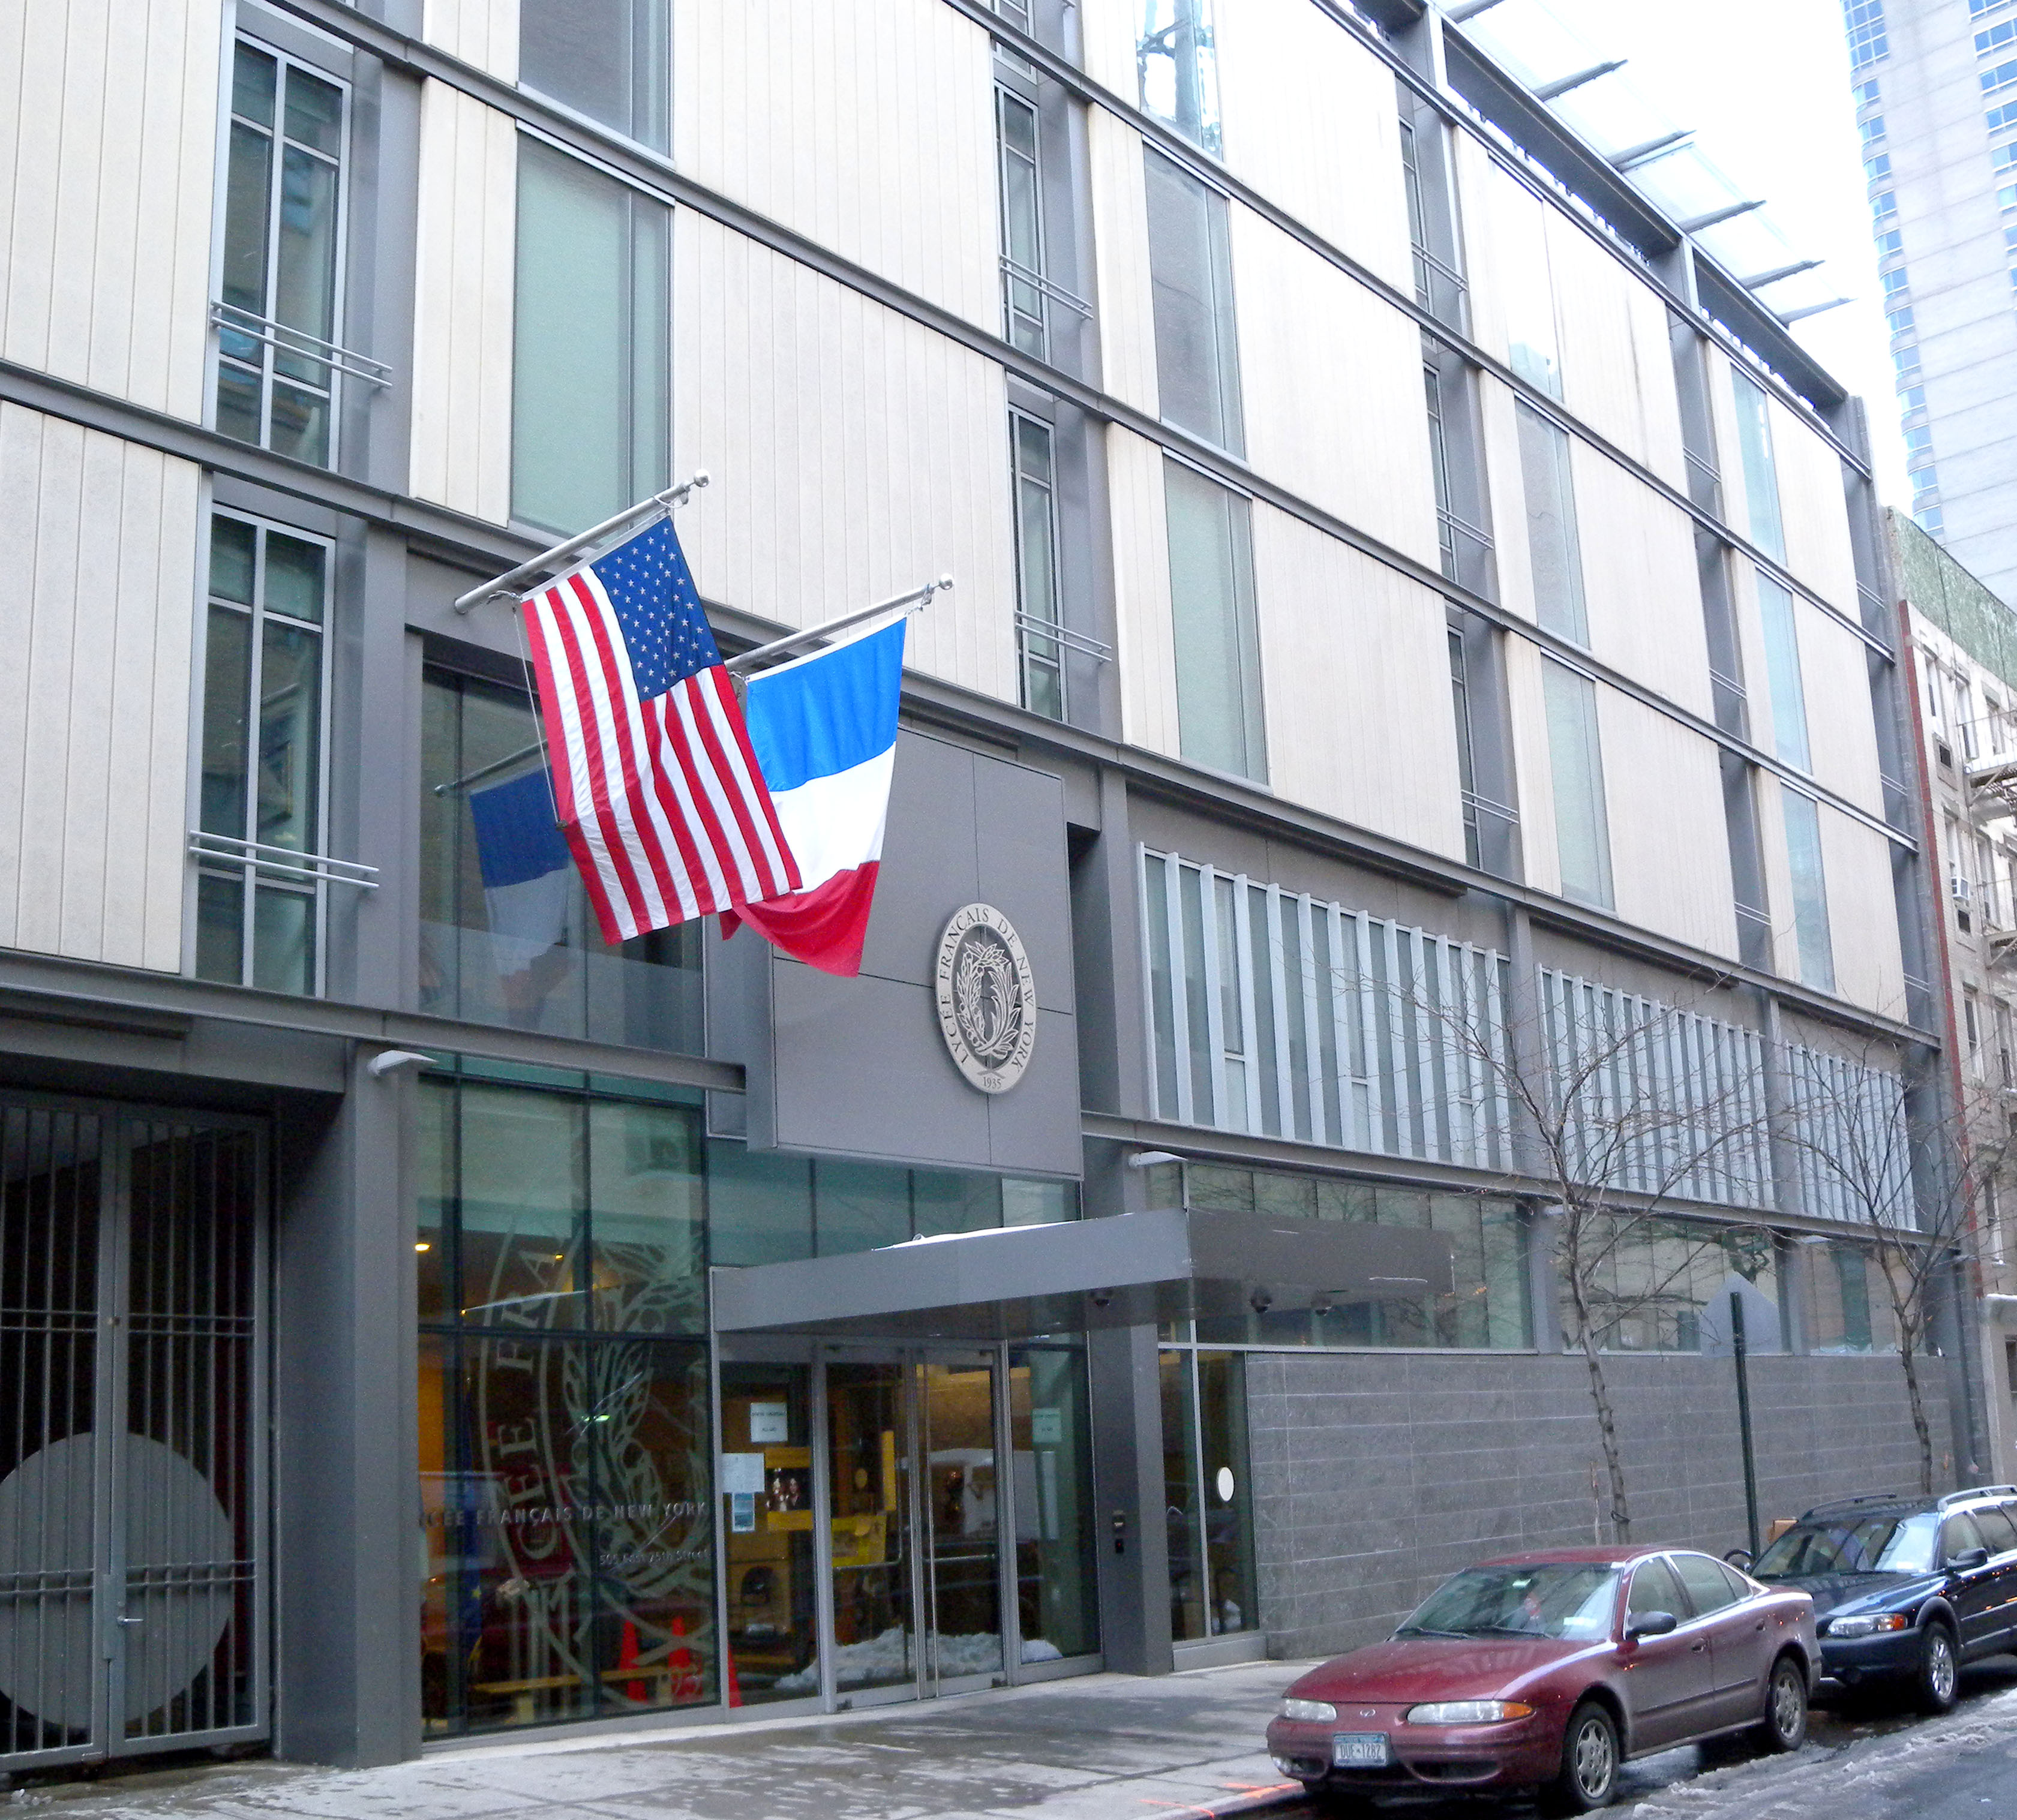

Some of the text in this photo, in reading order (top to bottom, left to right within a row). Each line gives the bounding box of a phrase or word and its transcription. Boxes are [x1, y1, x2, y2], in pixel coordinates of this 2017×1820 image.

[997, 919, 1017, 948] DE
[1016, 956, 1034, 1007] NEW
[1011, 1022, 1034, 1074] YORK
[984, 1077, 1001, 1089] 1935
[583, 1506, 608, 1522] DE
[614, 1503, 653, 1519] NEW
[664, 1501, 706, 1517] YORK
